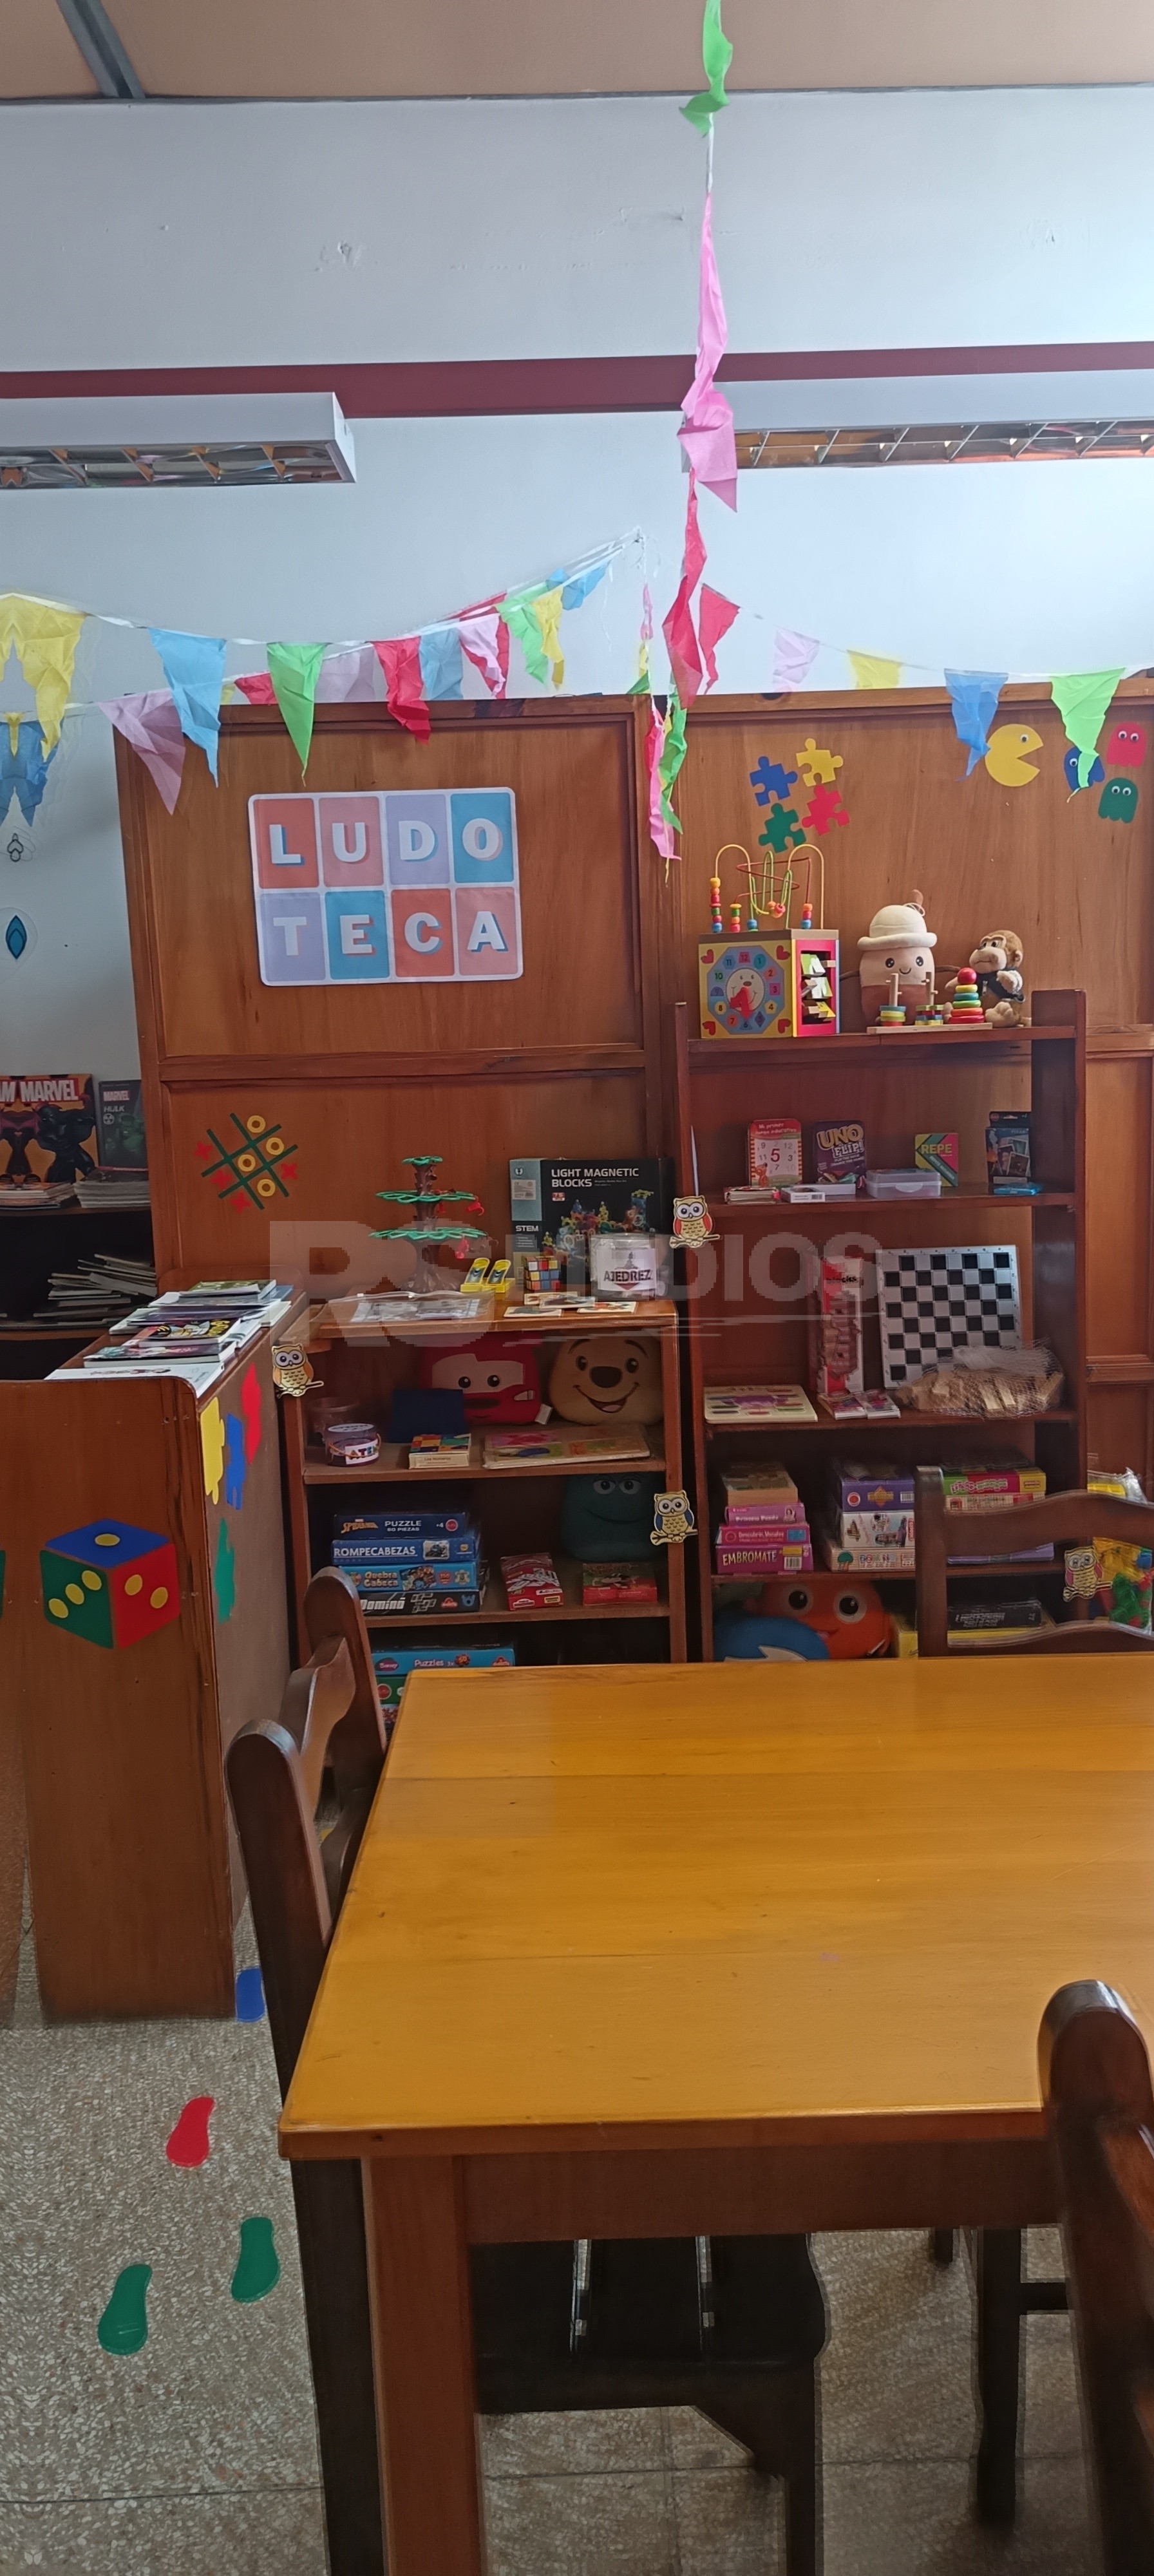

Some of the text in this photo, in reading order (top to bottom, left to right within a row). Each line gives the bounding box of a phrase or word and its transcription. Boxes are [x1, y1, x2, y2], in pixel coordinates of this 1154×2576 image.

[269, 818, 502, 866] LUDO
[273, 911, 508, 956] TECA
[19, 1079, 79, 1103] MARVEL
[103, 1090, 129, 1102] MARVEL
[817, 1124, 864, 1151] UNO
[771, 1148, 780, 1162] 5
[833, 1141, 864, 1157] FLIP!
[921, 1143, 952, 1154] REPE
[551, 1168, 639, 1178] LIGHT MAGNETIC
[552, 1179, 592, 1188] BLOCKS
[603, 1269, 652, 1282] AJEDREZ
[334, 1546, 416, 1557] ROMPECABEZAS
[723, 1549, 777, 1566] EMBROMATE
[364, 1571, 397, 1580] Quebra
[414, 1659, 444, 1667] Puzzles
